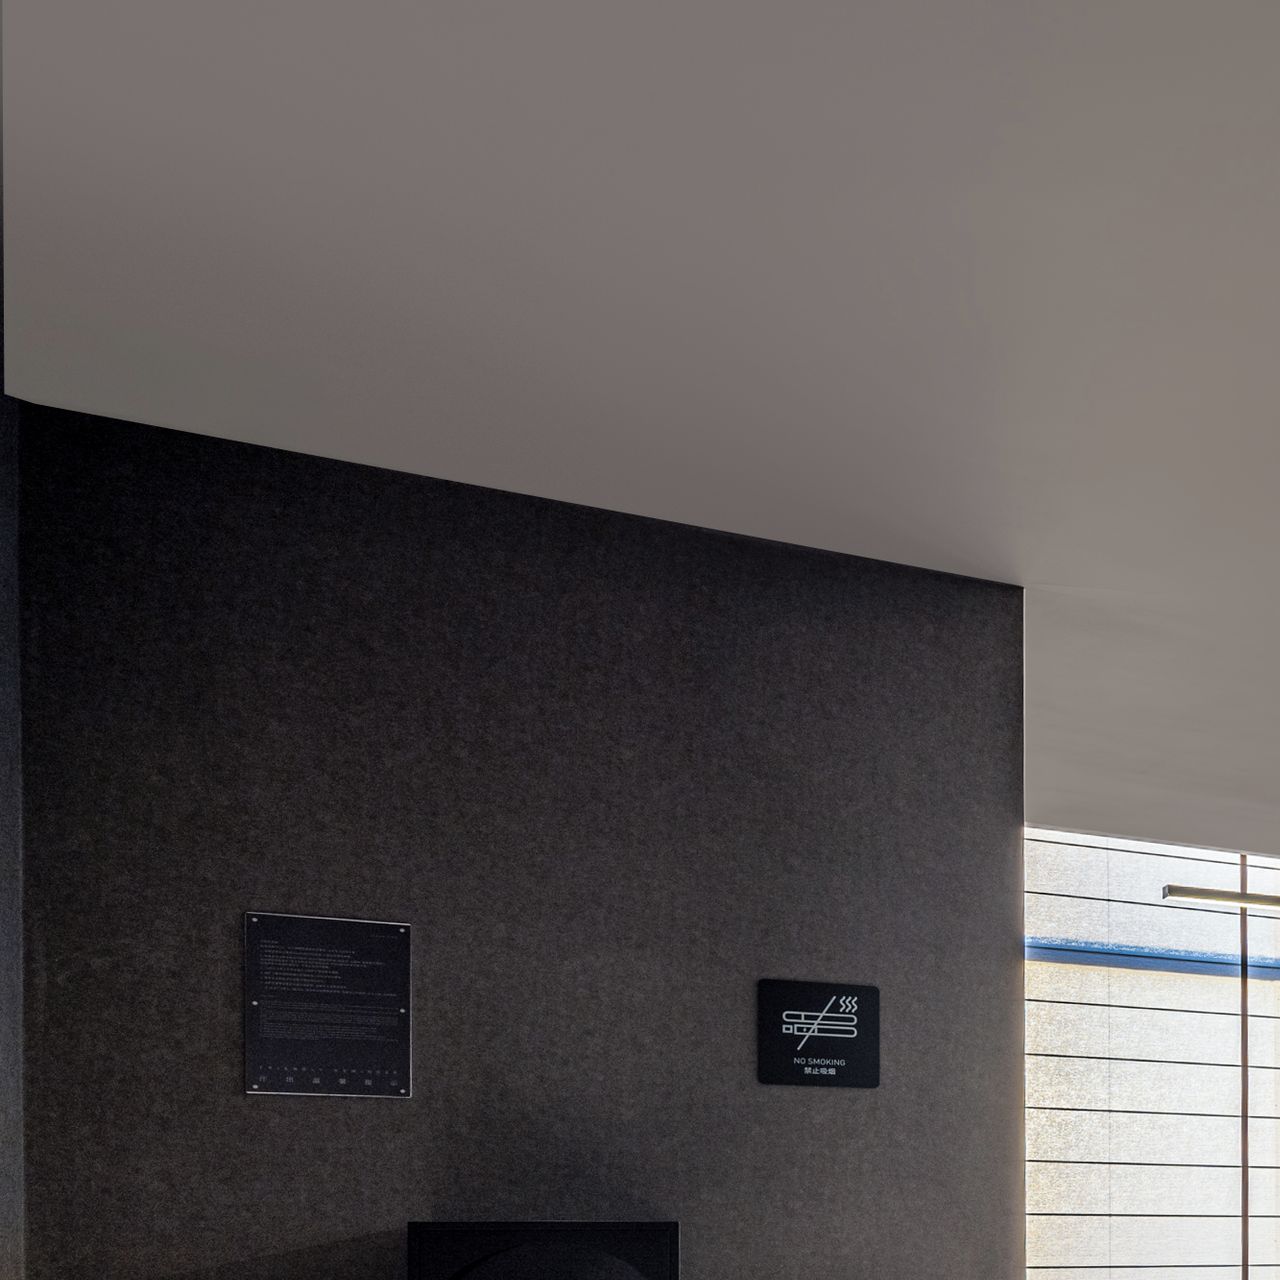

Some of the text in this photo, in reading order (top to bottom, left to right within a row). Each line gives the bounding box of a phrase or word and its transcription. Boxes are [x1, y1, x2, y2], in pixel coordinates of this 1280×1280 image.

[793, 1057, 846, 1067] NO SMOKING
[804, 1066, 836, 1075] 禁止吸烟
